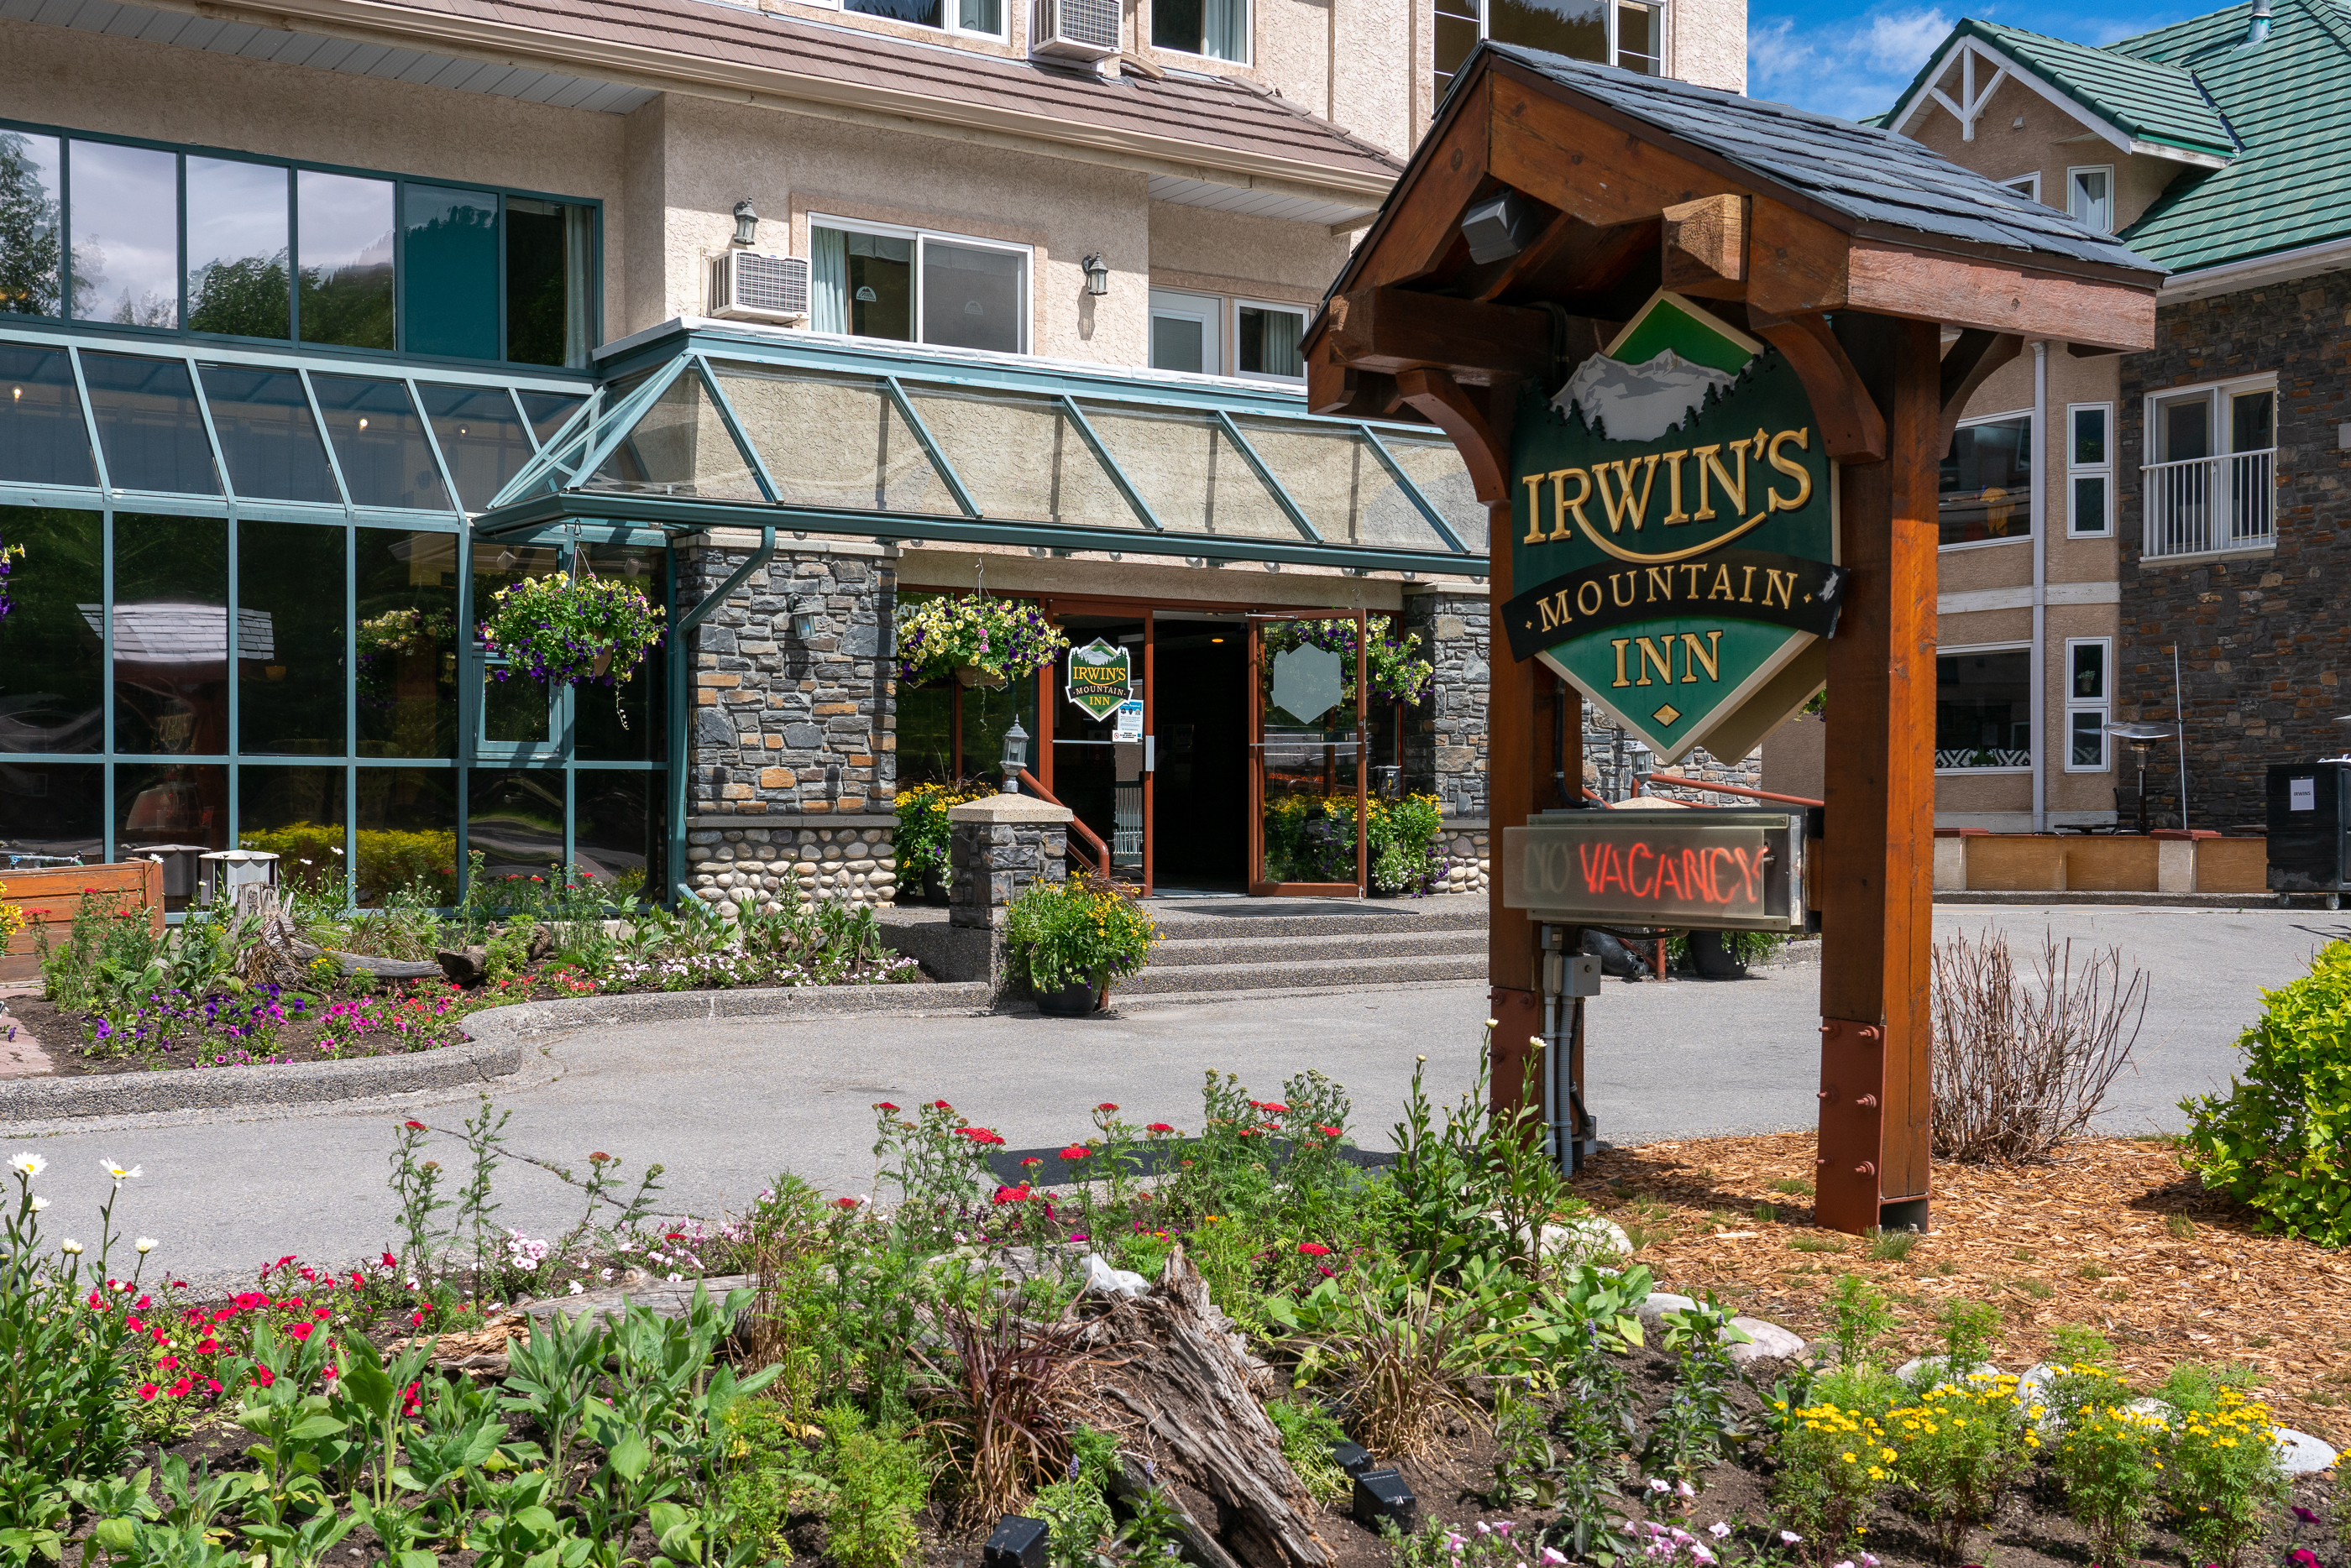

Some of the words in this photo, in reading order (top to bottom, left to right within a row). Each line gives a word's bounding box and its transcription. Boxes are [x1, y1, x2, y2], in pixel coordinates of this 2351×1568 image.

[1522, 426, 1811, 563] IRWIN'S
[1536, 563, 1799, 633] MOUNTAIN
[1072, 666, 1127, 686] IRWIN'S
[1611, 630, 1723, 688] INN
[1076, 685, 1124, 697] MOUNTAIN
[1089, 696, 1111, 706] INN
[1579, 842, 1769, 904] VACANCY
